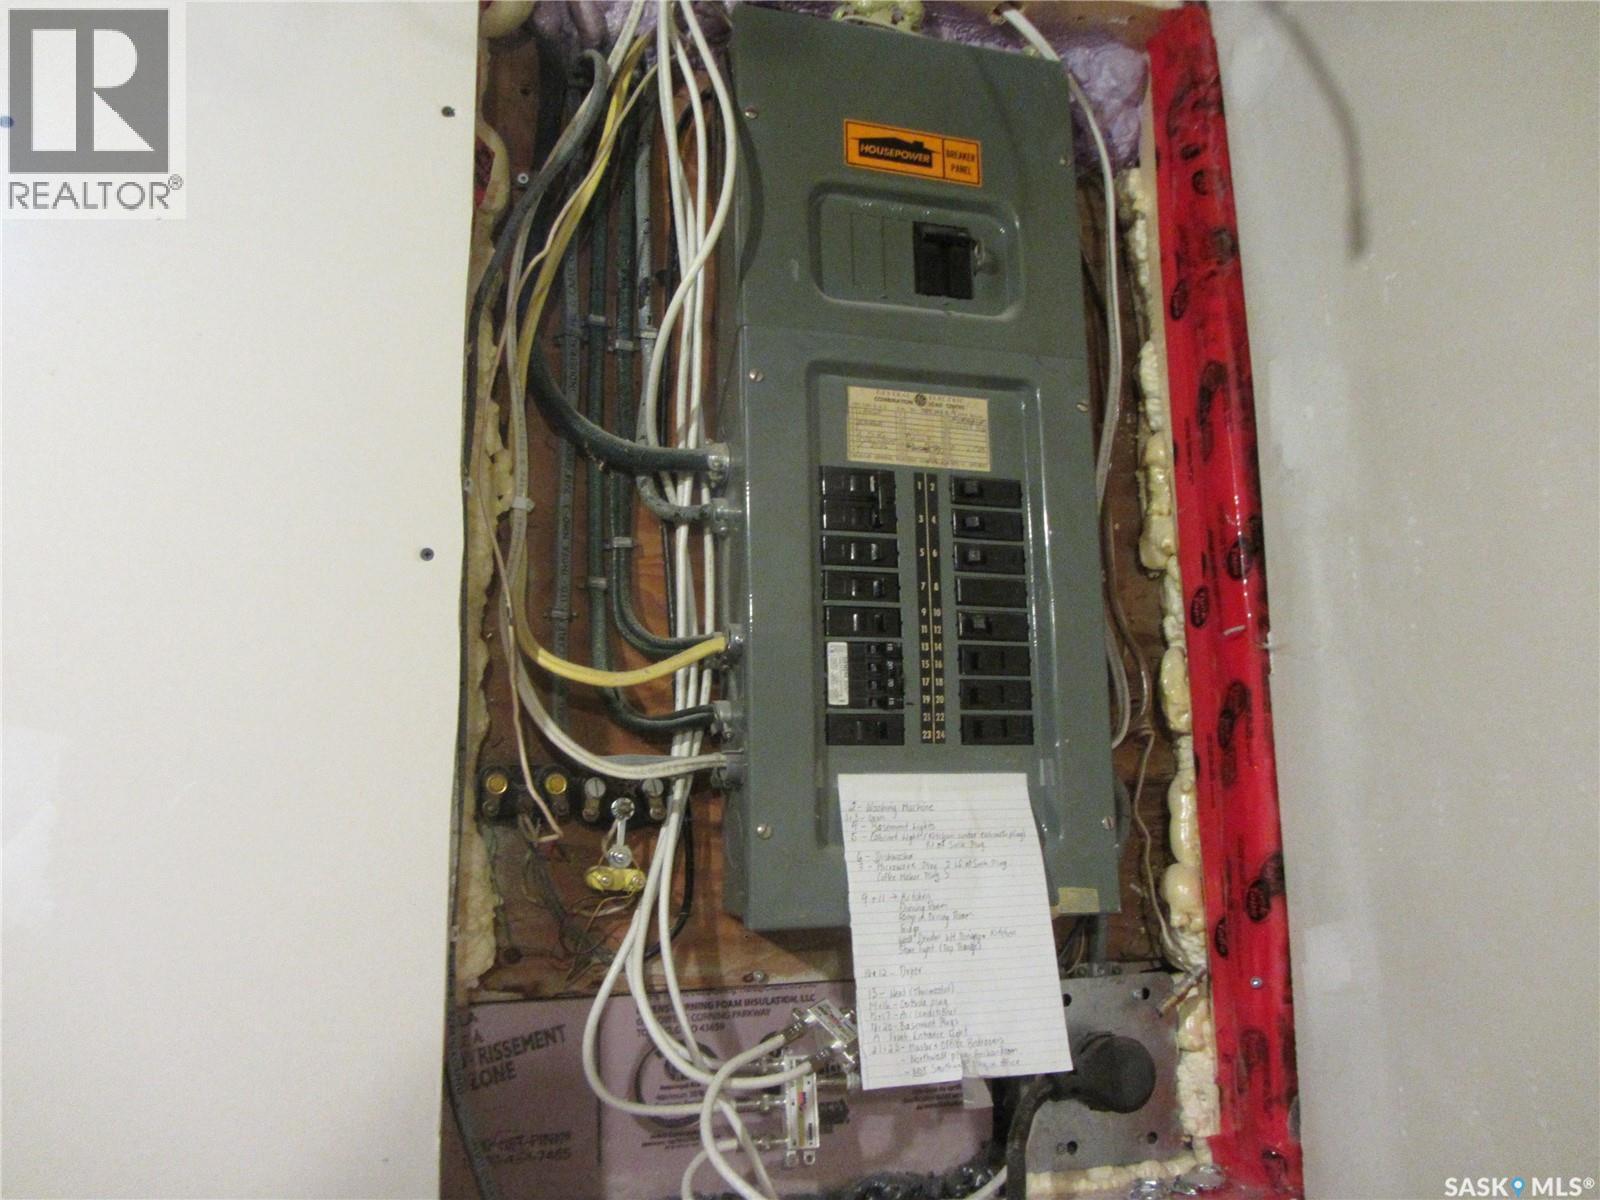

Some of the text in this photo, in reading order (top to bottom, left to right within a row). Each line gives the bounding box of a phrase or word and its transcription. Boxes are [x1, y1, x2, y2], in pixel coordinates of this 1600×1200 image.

[860, 144, 931, 163] HOUSEPOWER
[945, 149, 975, 162] BREAKER
[951, 165, 971, 175] PANEL
[917, 481, 935, 491] 1 2
[918, 515, 936, 523] 3 4
[920, 548, 938, 557] 5 6
[921, 582, 939, 591] 7 8
[921, 608, 941, 617] 9 10
[921, 625, 942, 634] 11 12
[921, 643, 942, 651] 13 14
[921, 660, 943, 669] 15 16
[922, 677, 943, 687] 17 18
[922, 695, 944, 704] 19 20
[923, 713, 945, 722] 21 22
[922, 730, 945, 739] 23 24
[902, 803, 934, 812] Machine
[715, 999, 743, 1009] FOAM
[800, 993, 816, 1003] LLC
[732, 1008, 772, 1019] PARKWAY
